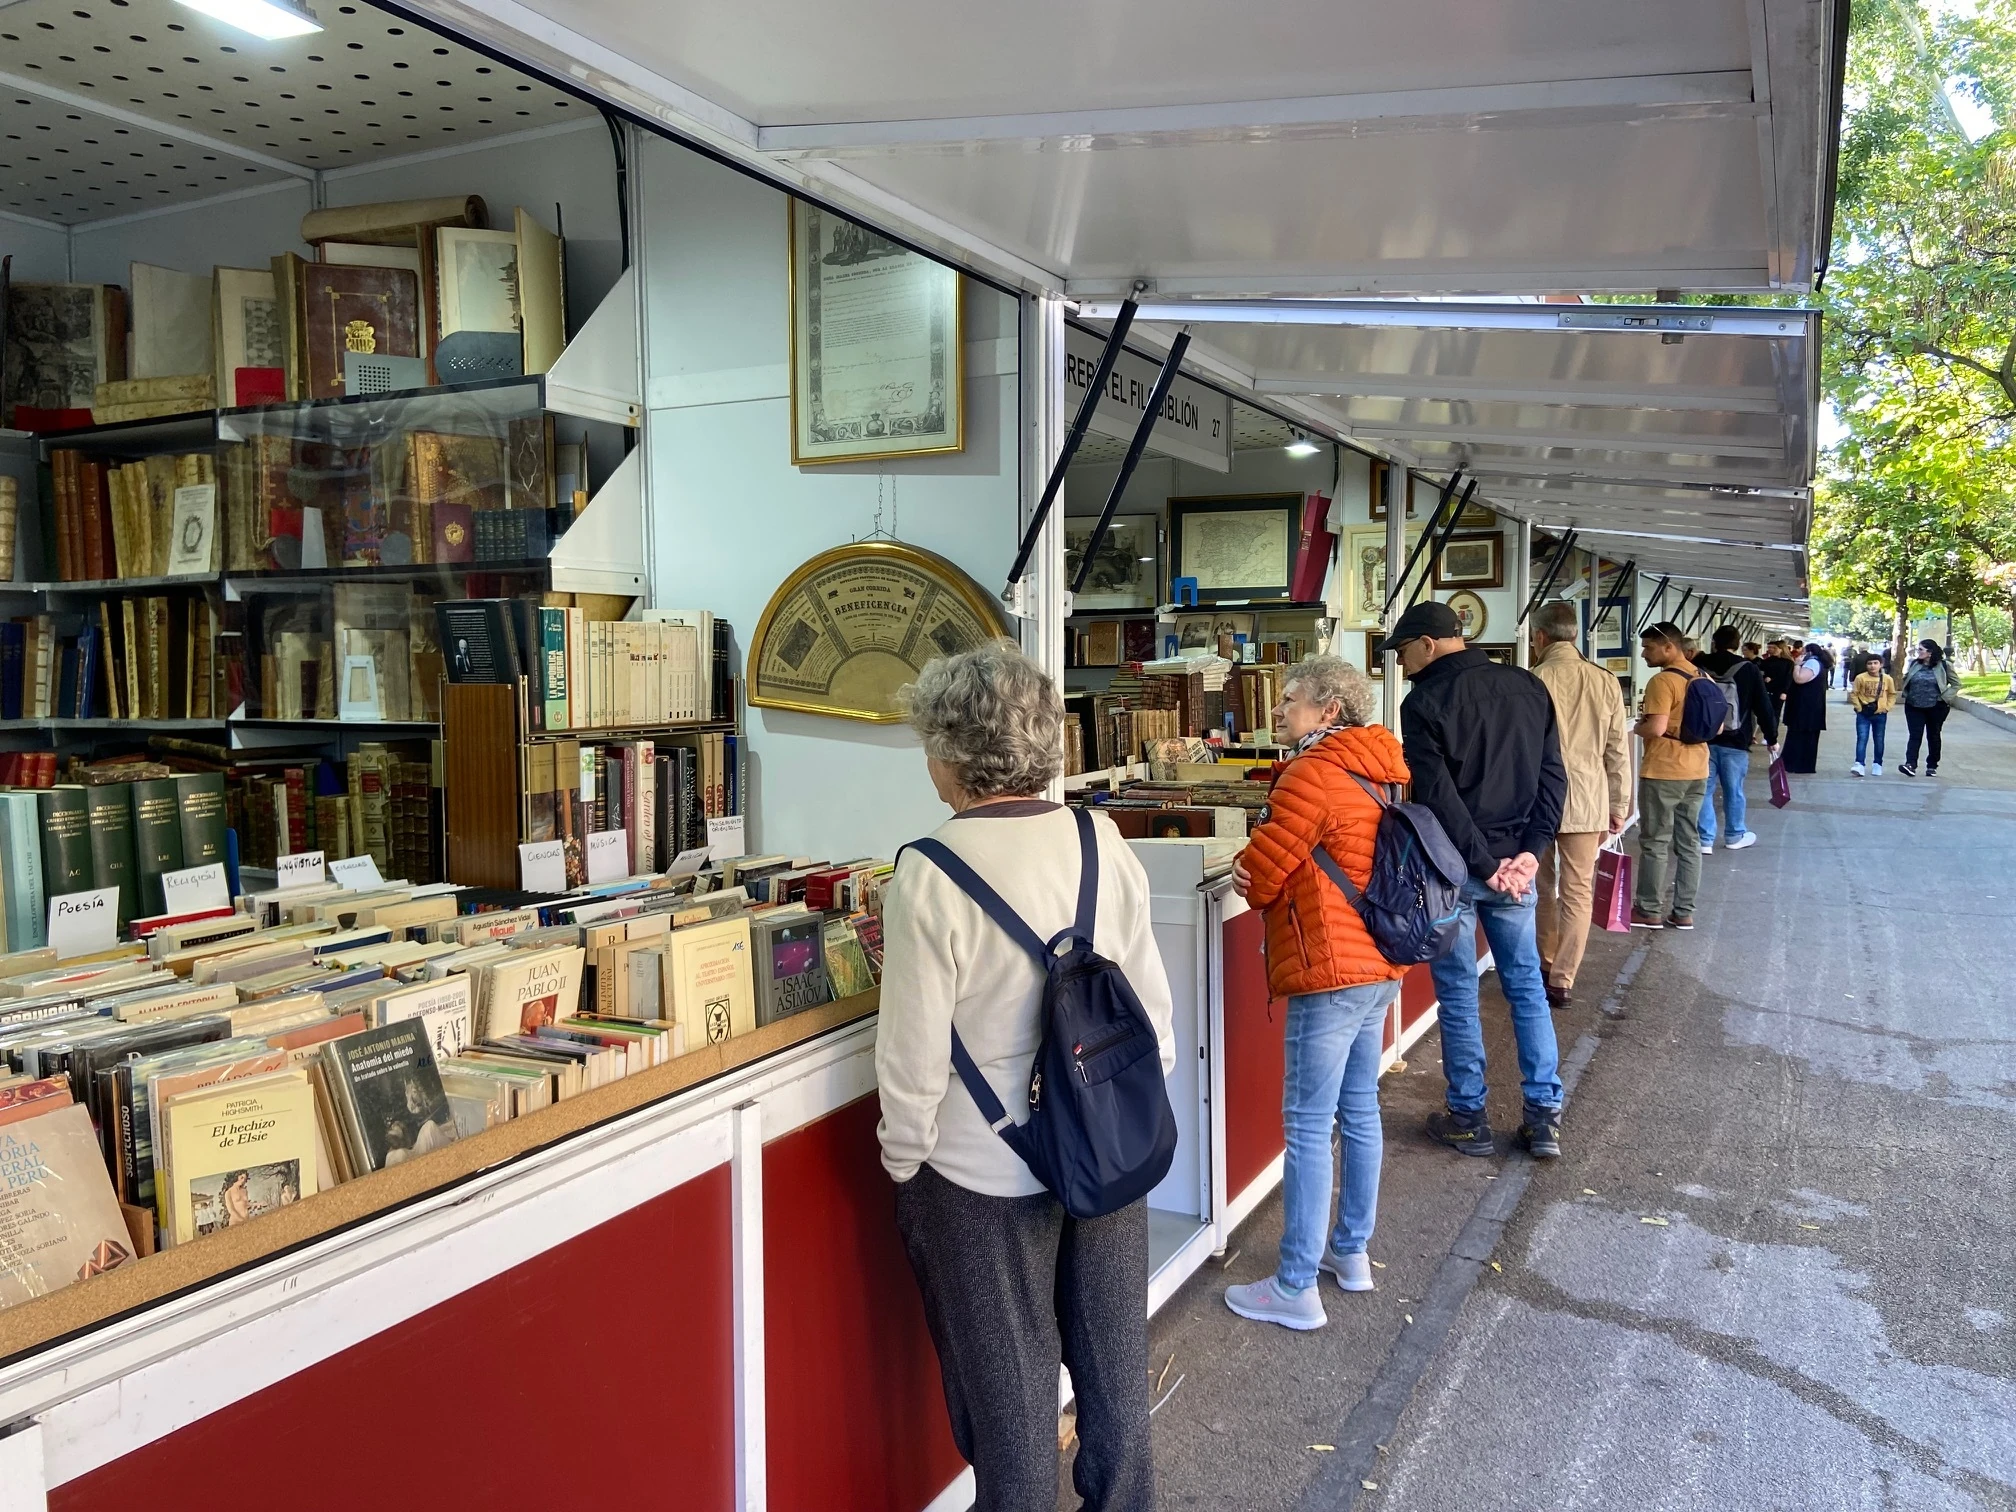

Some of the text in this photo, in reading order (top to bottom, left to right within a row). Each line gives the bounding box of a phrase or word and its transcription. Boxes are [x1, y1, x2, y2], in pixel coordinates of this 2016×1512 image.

[1111, 371, 1127, 404] EL
[1130, 379, 1199, 431] FILIBLIÓN
[1212, 418, 1221, 438] 27
[866, 585, 891, 593] CORRIDA
[834, 600, 908, 616] BENEFICENCIA
[557, 650, 565, 679] GUERRA
[557, 680, 565, 690] LA
[641, 789, 654, 872] Garden of Eden
[590, 836, 618, 850] MÚSICA
[527, 848, 561, 862] CIENCIAS
[58, 895, 104, 917] POESÍA
[494, 915, 518, 927] Sánchez
[517, 913, 532, 923] Vidal
[489, 924, 516, 937] Miguel
[526, 960, 561, 985] JUAN
[516, 975, 568, 1002] PABLO II
[782, 971, 814, 995] ISAAC
[417, 997, 437, 1010] POESÍA
[458, 997, 467, 1005] GIL
[776, 985, 822, 1014] ASIMOV
[347, 1032, 416, 1061] JOSÉ ANTONIO MARINA
[351, 1046, 414, 1073] Anatomía del miedo
[221, 1104, 263, 1117] HIGHSMITH
[226, 1098, 258, 1110] PATRICIA
[211, 1118, 276, 1138] El hechizo
[121, 1106, 134, 1178] SOSPECHOSO
[219, 1131, 268, 1148] de Elsie
[15, 1208, 37, 1220] SORIA
[17, 1211, 51, 1227] GALINDO
[36, 1235, 68, 1252] SORIANO
